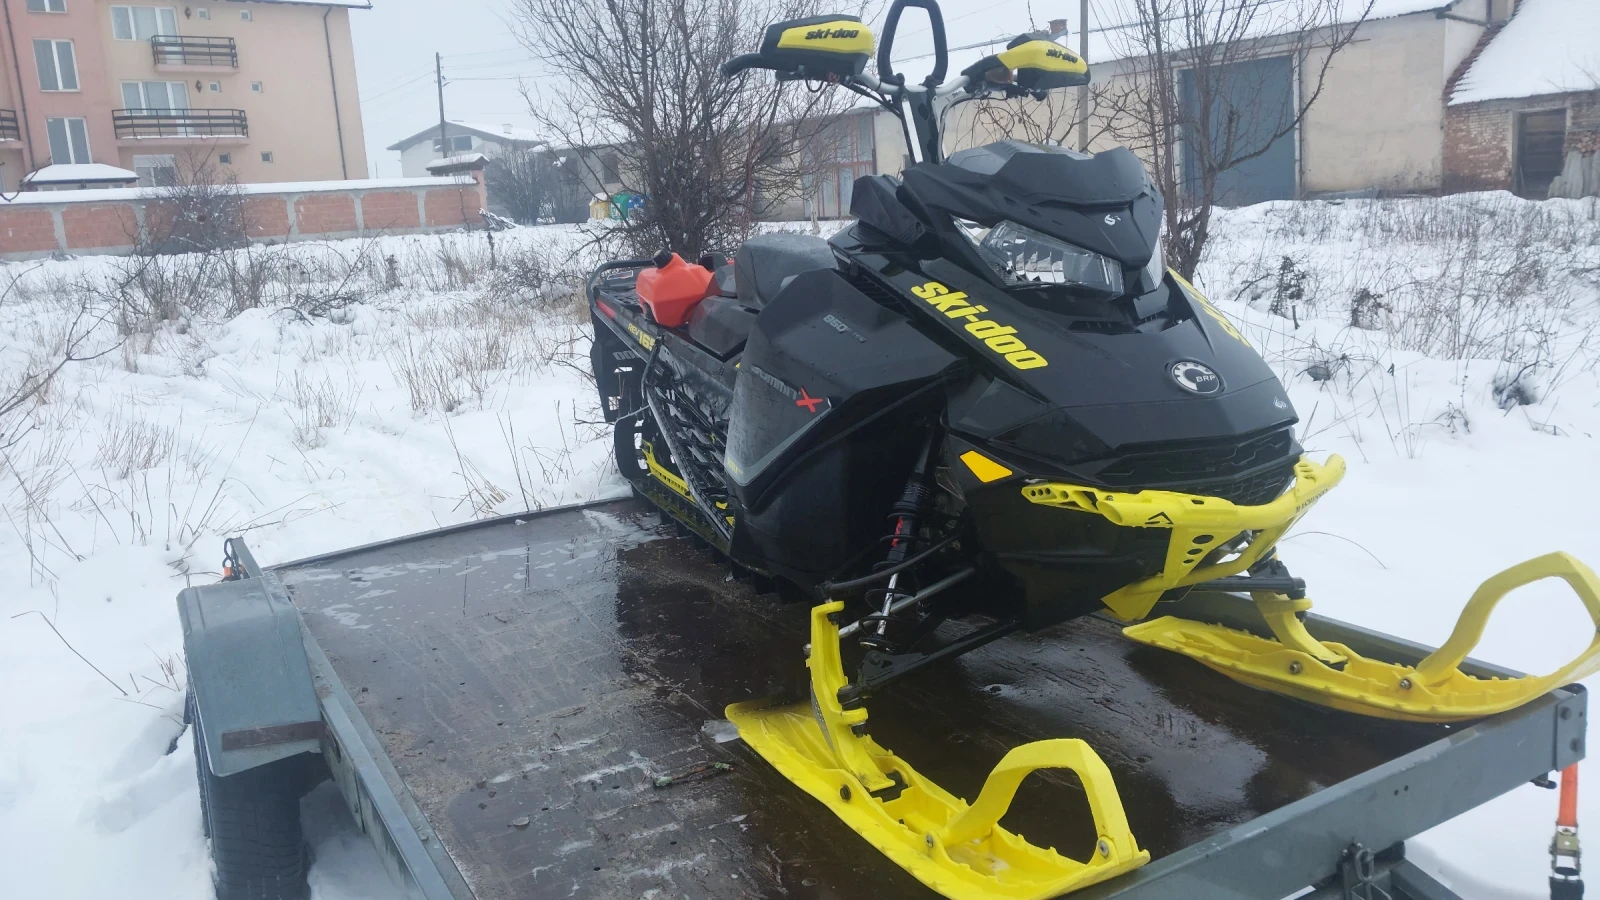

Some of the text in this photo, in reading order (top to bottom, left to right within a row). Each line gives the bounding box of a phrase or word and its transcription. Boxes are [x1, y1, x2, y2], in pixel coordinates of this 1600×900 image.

[805, 28, 859, 40] ski-doo
[1046, 48, 1078, 63] ski-doo
[823, 314, 849, 332] 850
[910, 281, 1049, 370] ski-doo
[1195, 374, 1216, 383] BRP
[795, 387, 823, 413] X
